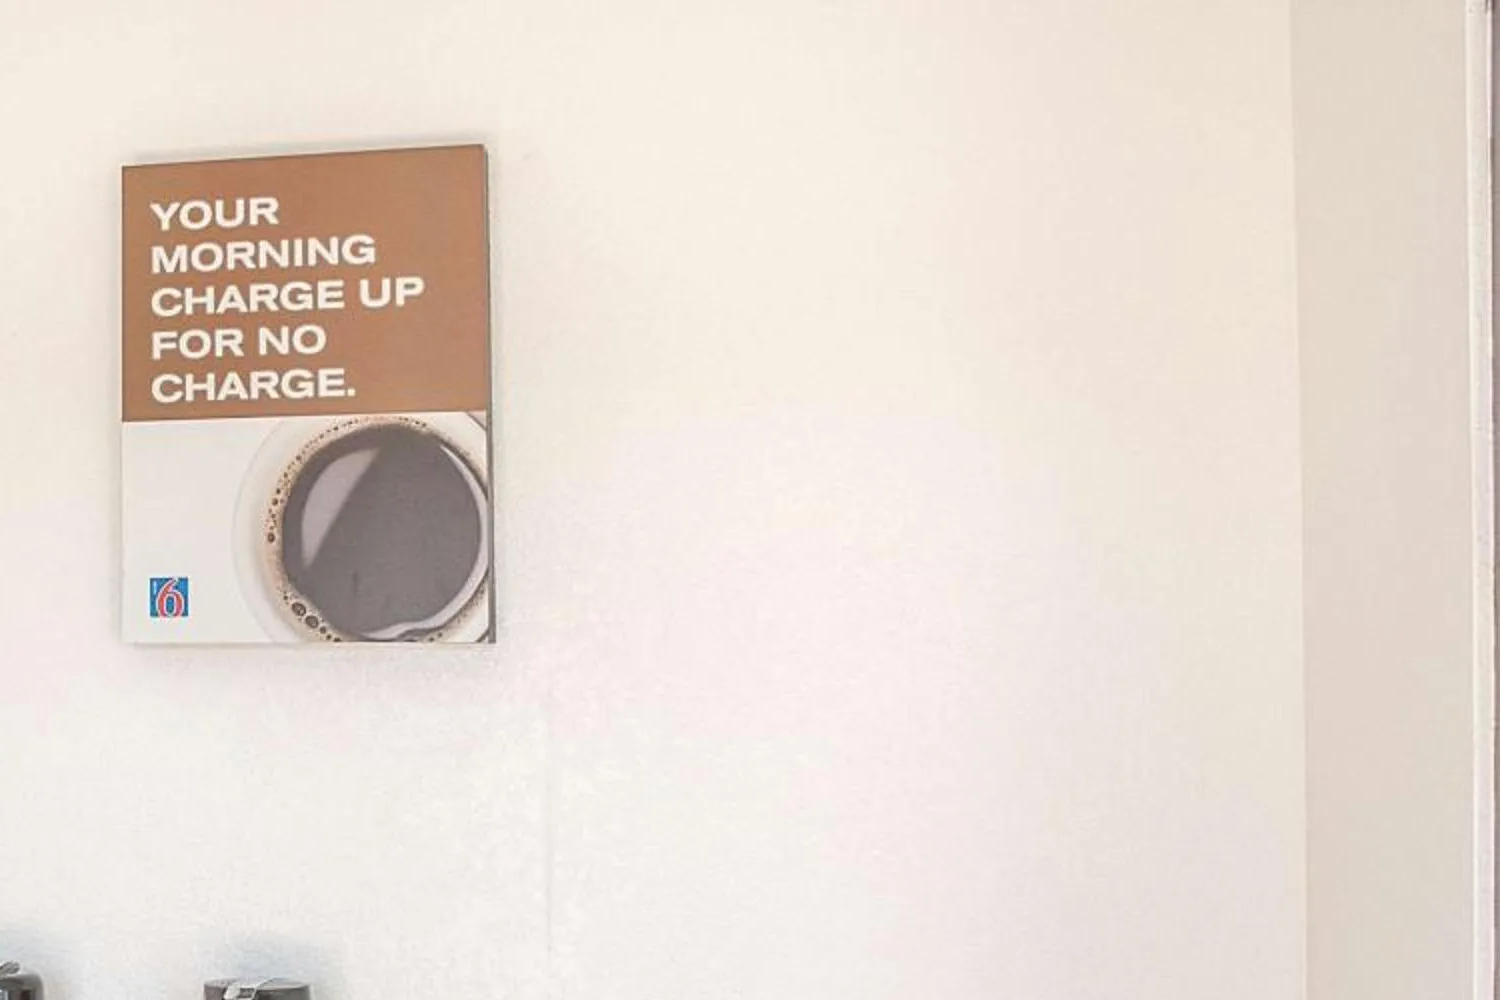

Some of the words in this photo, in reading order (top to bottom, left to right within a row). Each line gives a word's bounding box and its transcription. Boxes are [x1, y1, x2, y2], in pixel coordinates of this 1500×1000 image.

[150, 197, 280, 231] YOUR
[151, 234, 376, 274] MORNING
[151, 280, 345, 317] CHARGE
[359, 276, 425, 308] UP
[151, 328, 245, 360] FOR
[258, 324, 327, 355] NO
[151, 367, 356, 403] CHARGE.
[155, 576, 185, 619] 6
